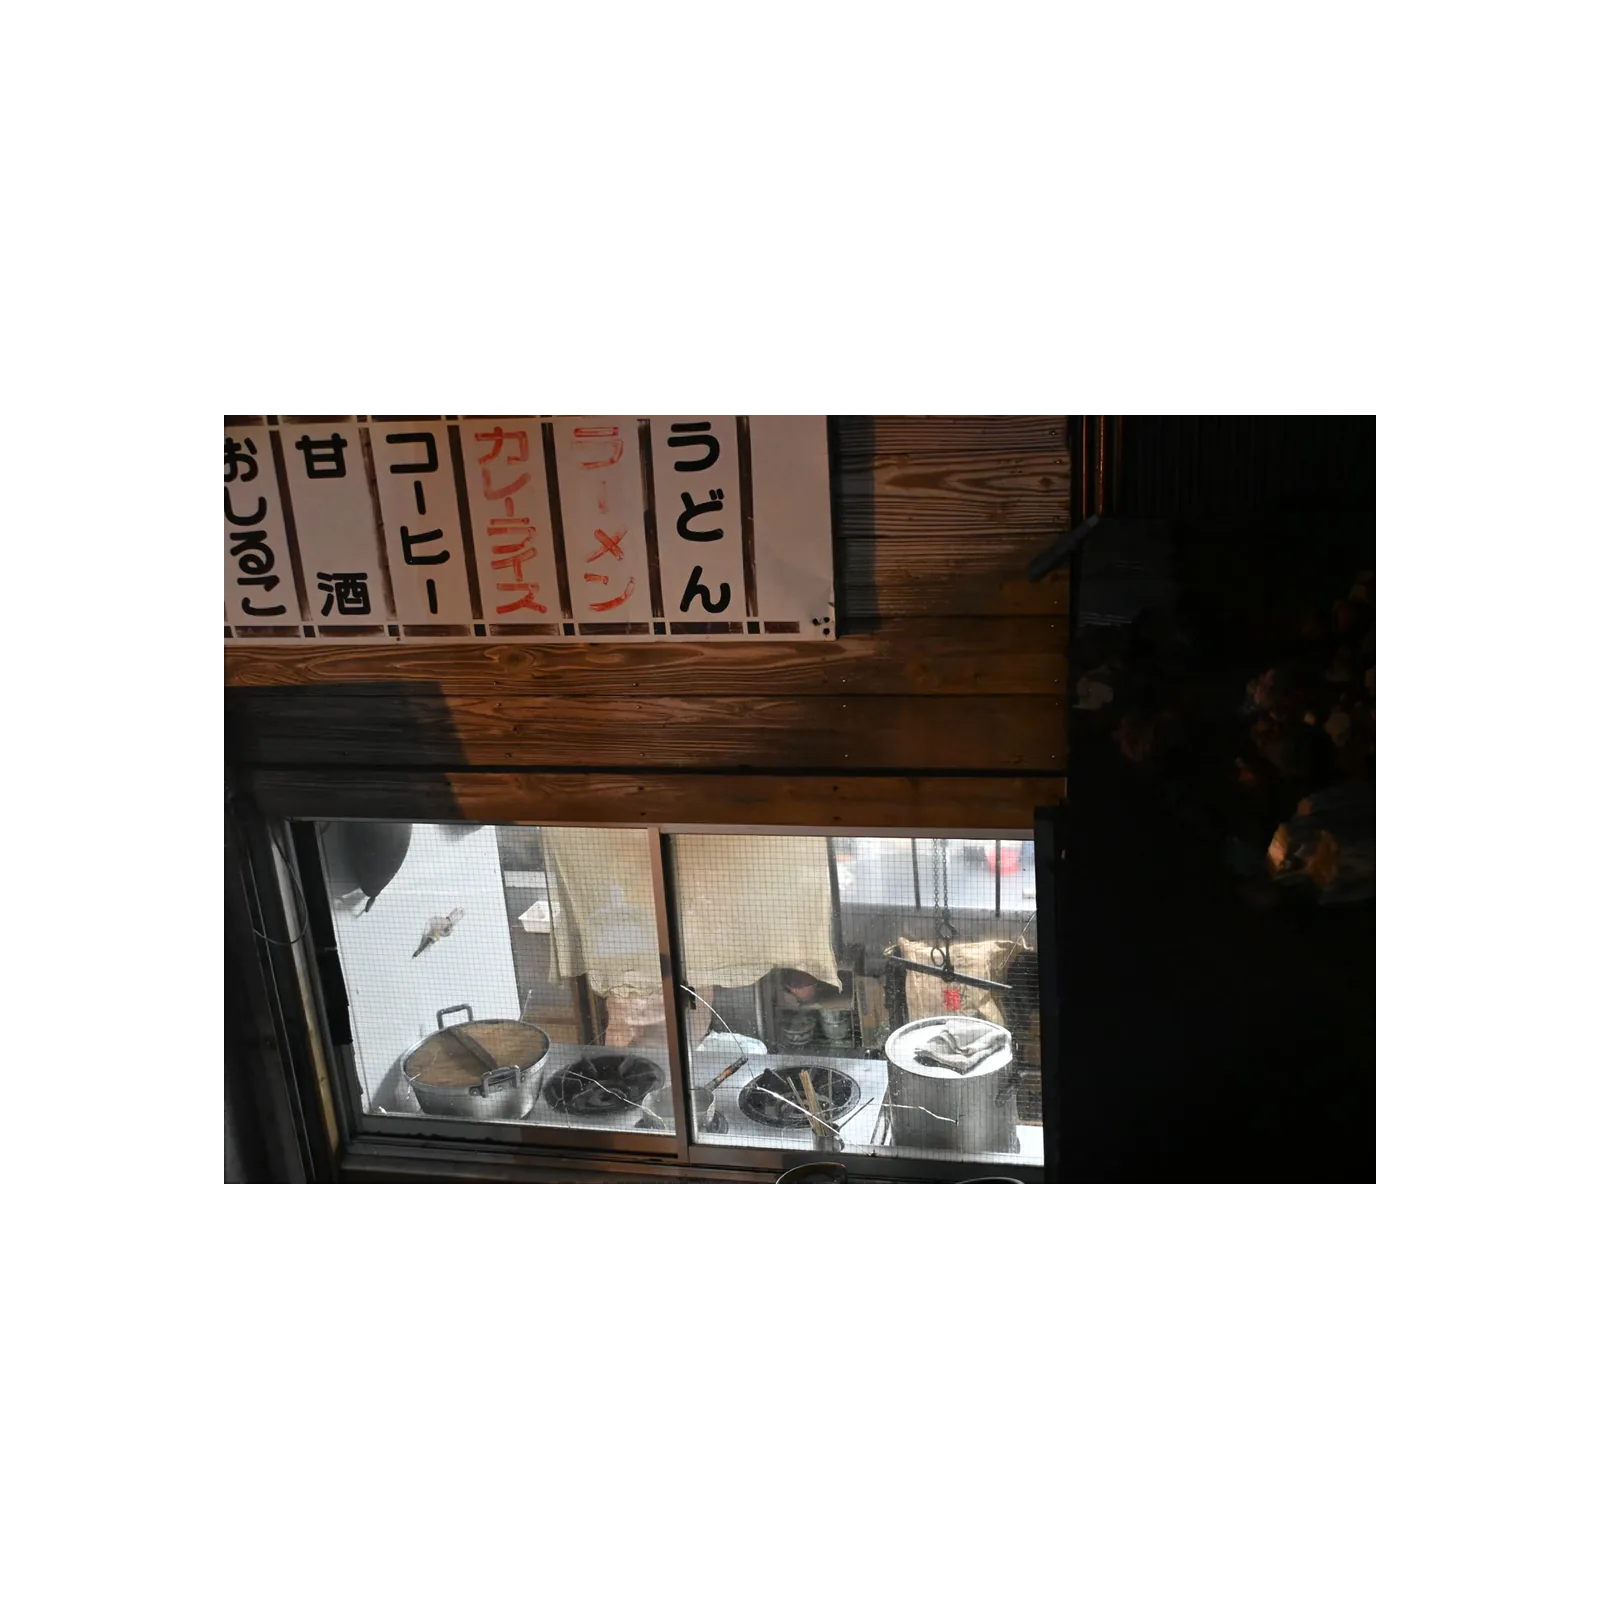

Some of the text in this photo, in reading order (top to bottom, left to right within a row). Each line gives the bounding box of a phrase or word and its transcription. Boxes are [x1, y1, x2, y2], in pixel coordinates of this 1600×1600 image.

[295, 432, 372, 617] 甘酒
[386, 432, 450, 614] コーヒー
[474, 426, 548, 614] カレーライス
[572, 426, 636, 613] ラーメン
[667, 421, 731, 613] うどん
